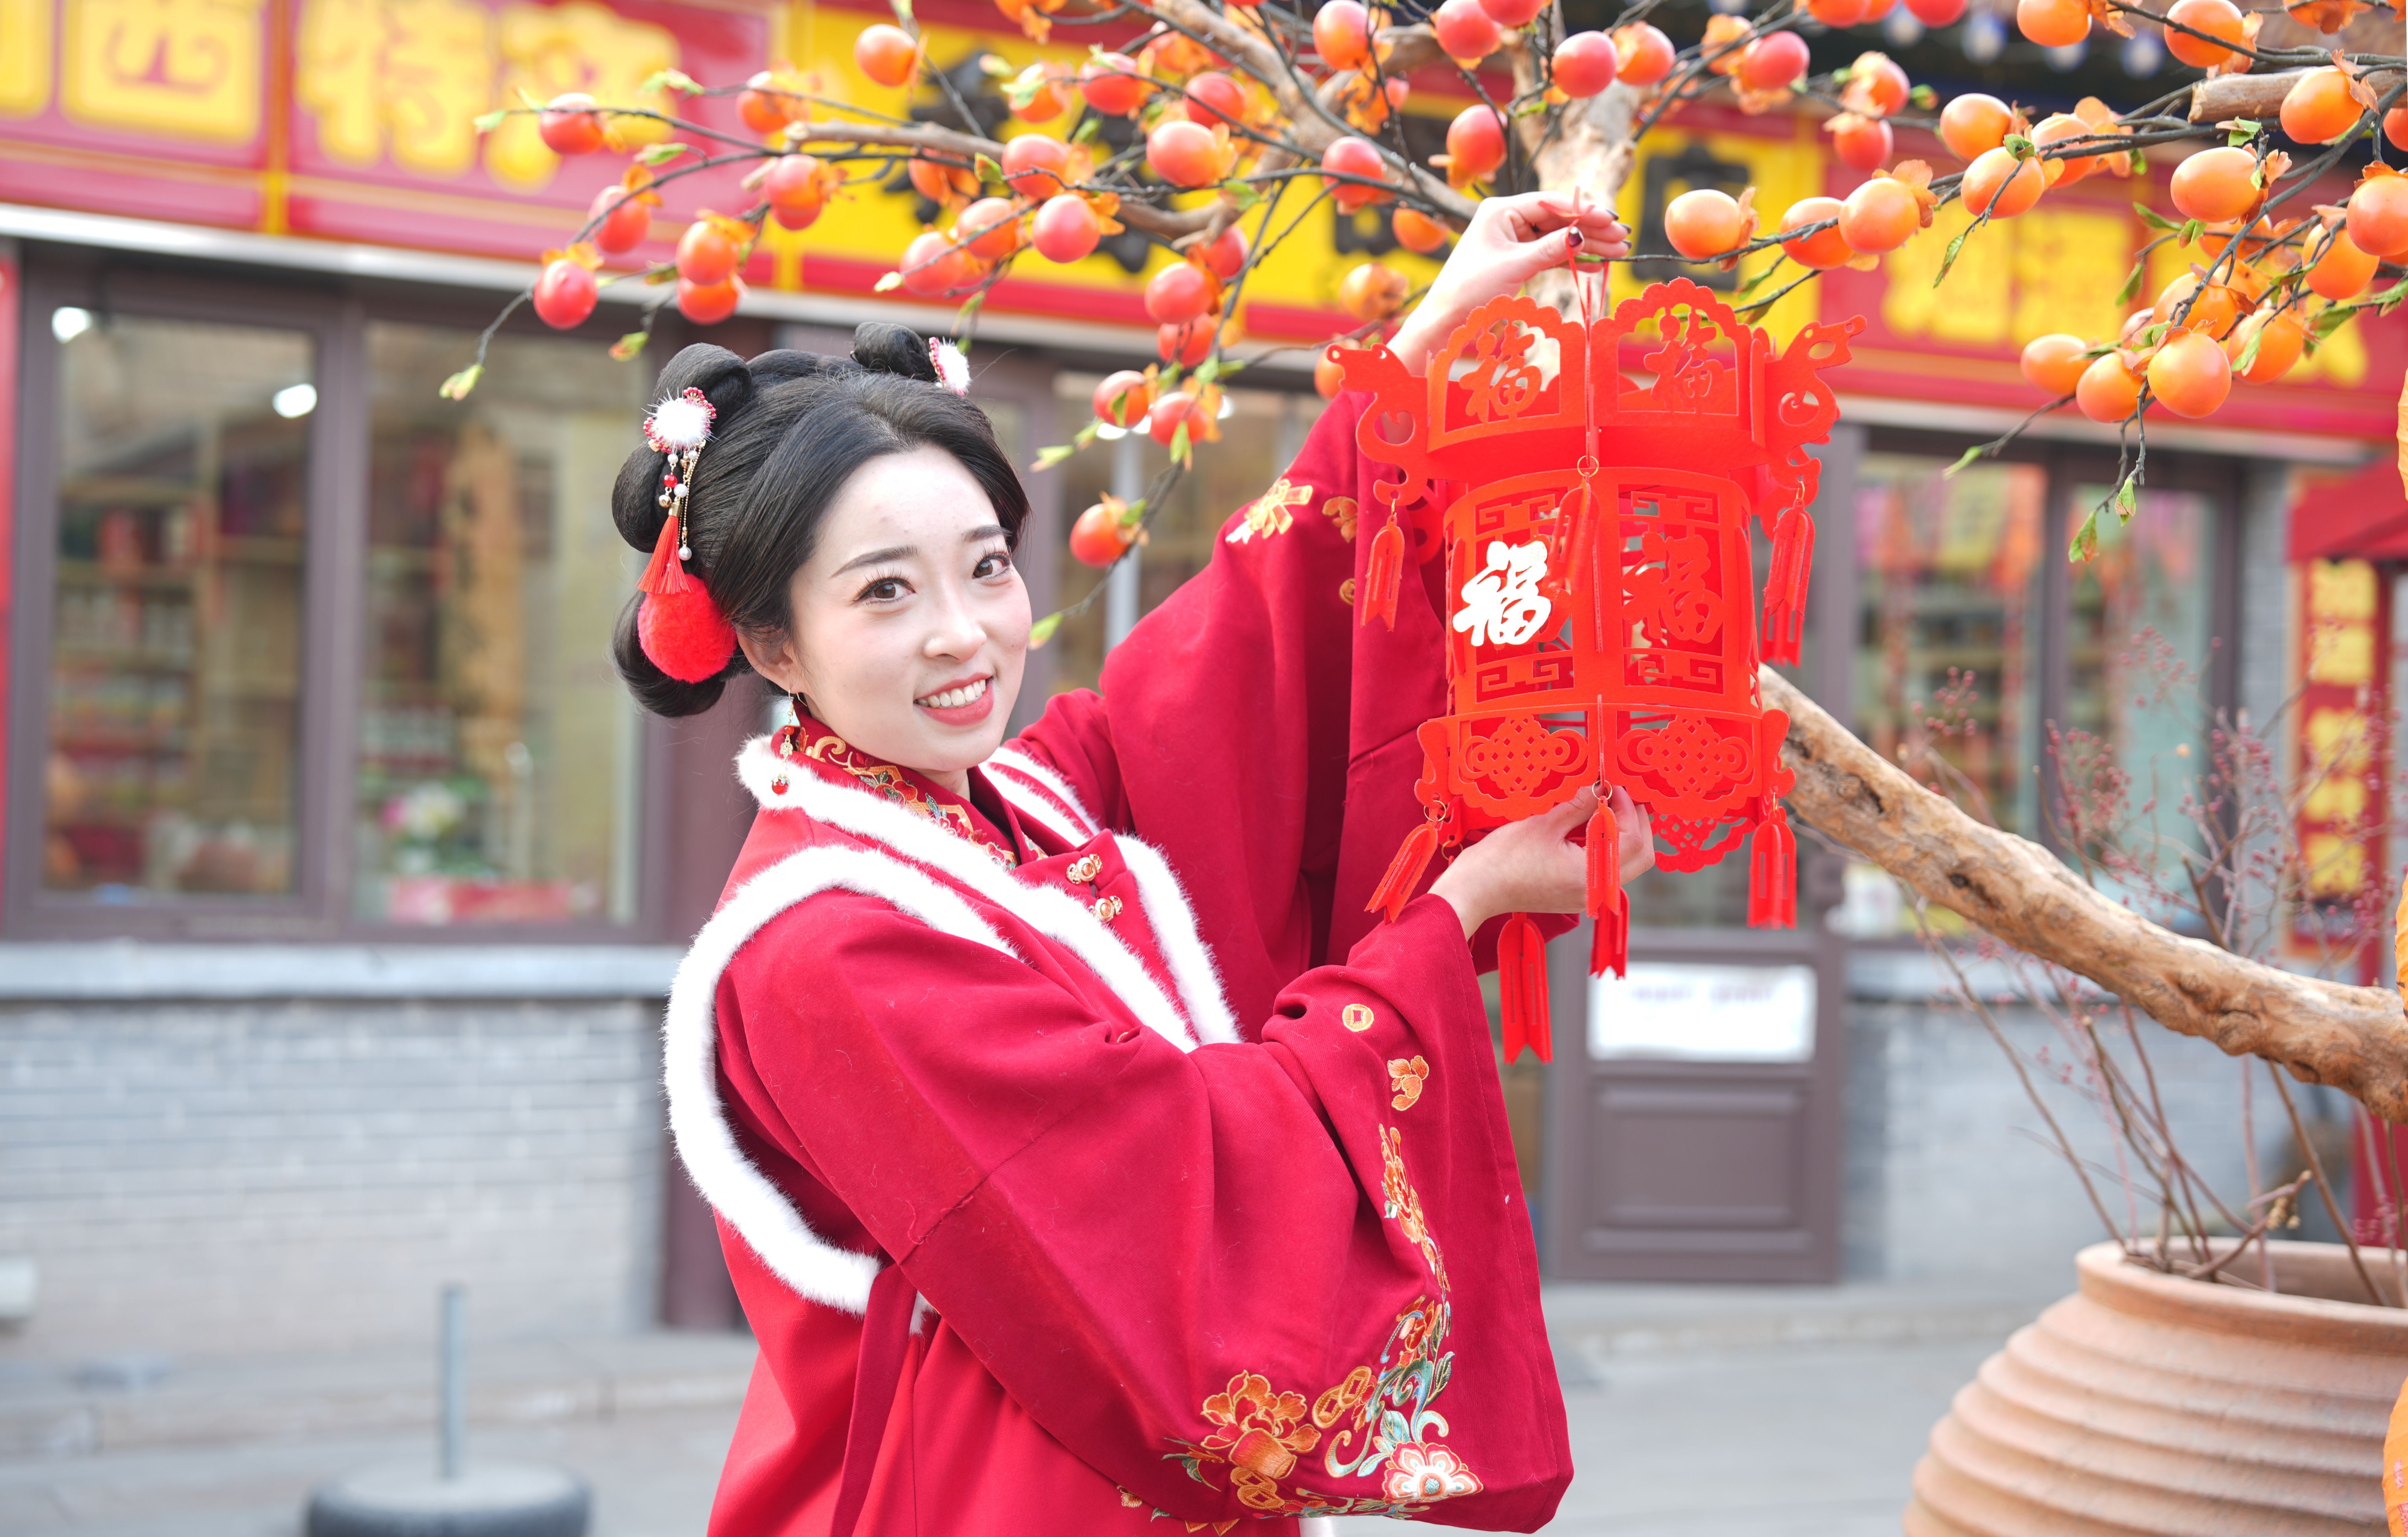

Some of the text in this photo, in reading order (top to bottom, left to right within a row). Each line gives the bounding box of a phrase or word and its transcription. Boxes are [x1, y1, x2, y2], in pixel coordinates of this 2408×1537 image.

[0, 0, 683, 190] 西特产
[1452, 539, 1552, 647] 福
[1622, 531, 1723, 643] 福
